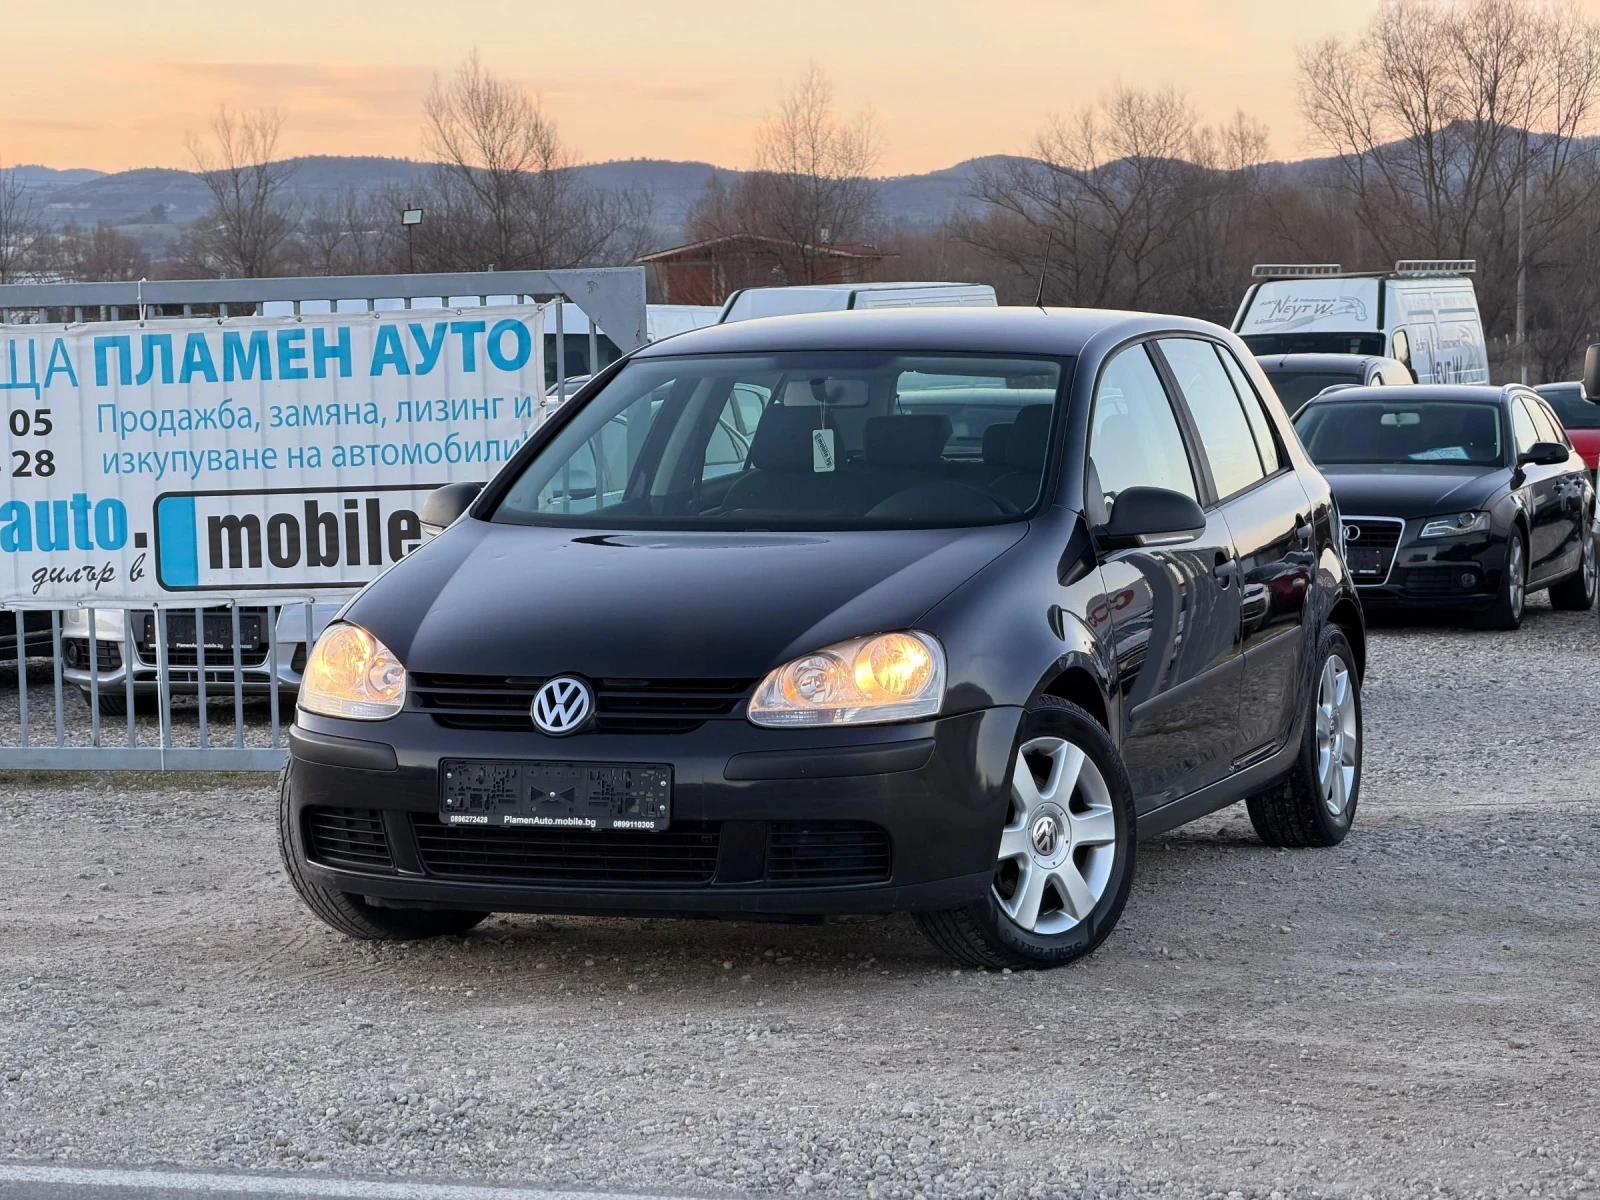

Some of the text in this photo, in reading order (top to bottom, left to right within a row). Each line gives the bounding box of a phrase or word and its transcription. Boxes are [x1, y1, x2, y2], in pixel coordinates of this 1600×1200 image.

[93, 326, 352, 387] ПЛАМЕН
[369, 318, 532, 377] АУТО
[9, 408, 53, 437] 05
[97, 395, 533, 441] Продажба, замяна, лизинг и
[11, 449, 56, 478] 28
[102, 446, 279, 481] изкупуване
[287, 448, 322, 469] на
[207, 498, 422, 570] mobile
[31, 552, 147, 595] дилър в
[532, 677, 591, 733] VW
[450, 815, 655, 829] 0896272428 PlamenAuto.mobile.bg 0899110305
